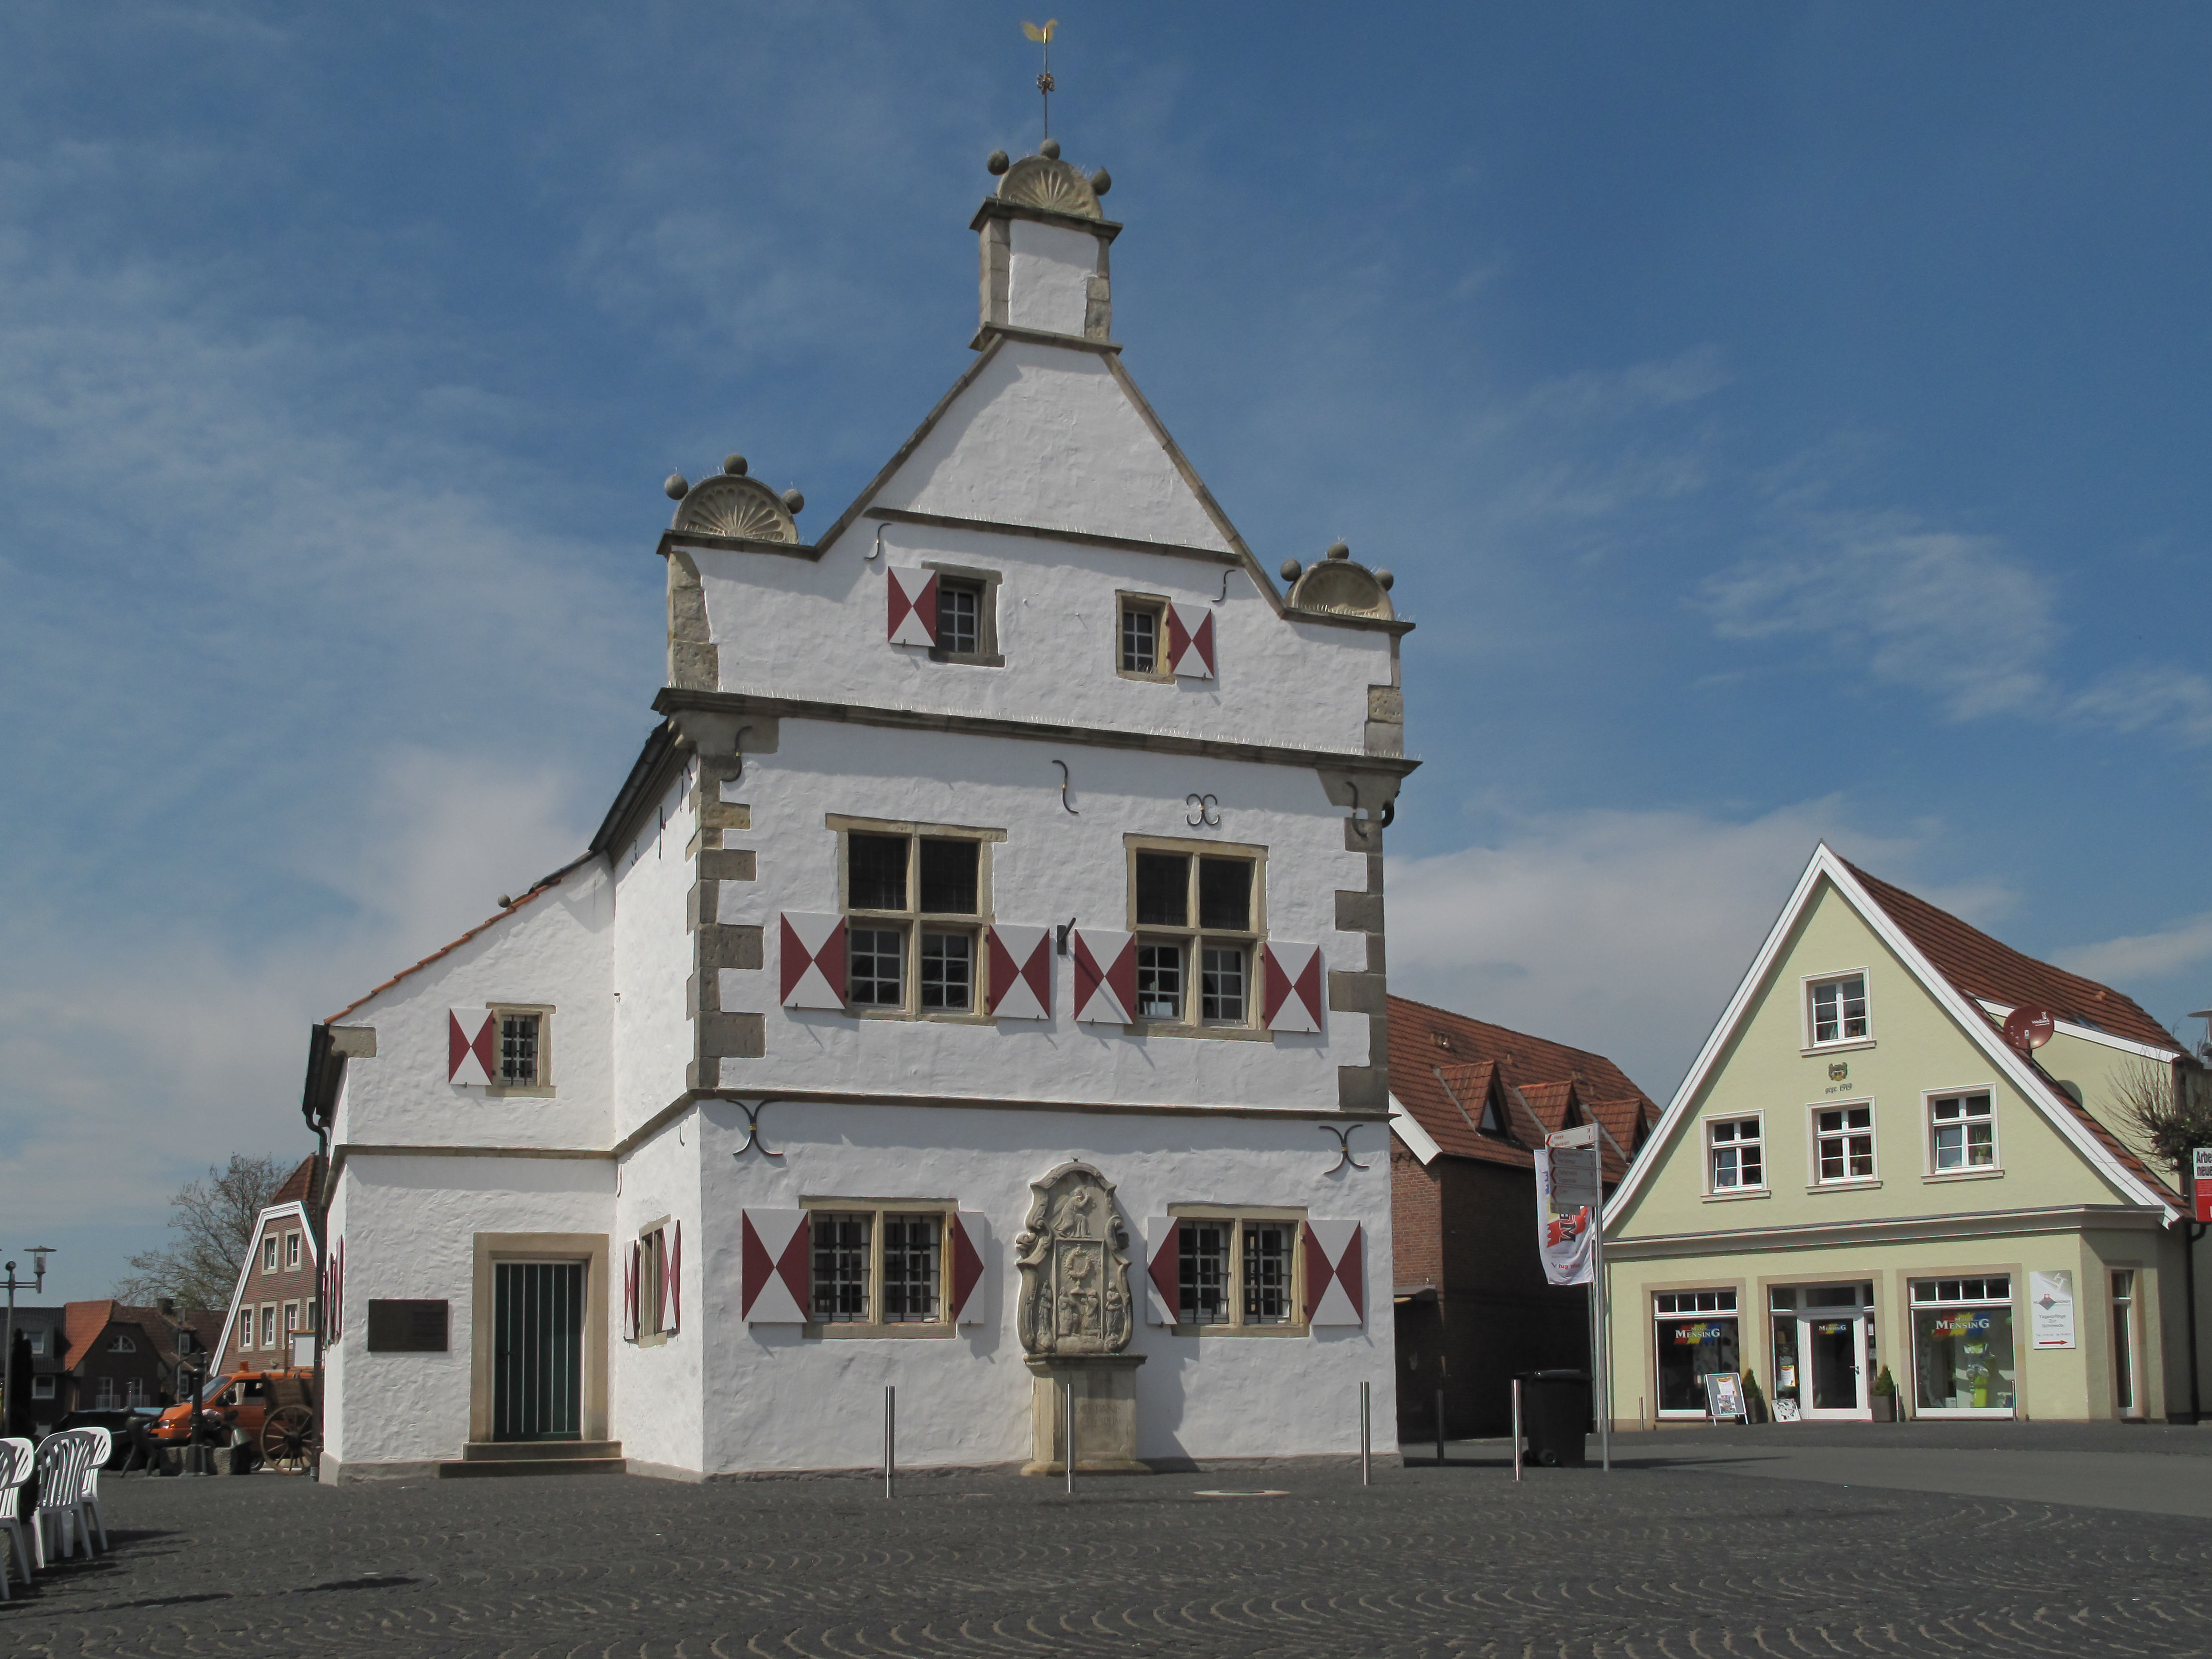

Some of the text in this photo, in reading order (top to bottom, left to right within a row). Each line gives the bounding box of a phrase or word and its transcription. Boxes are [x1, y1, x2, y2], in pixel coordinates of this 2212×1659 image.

[2196, 1151, 2212, 1164] Arbe
[1935, 1318, 1990, 1330] MENSING
[1675, 1328, 1721, 1338] MENSING
